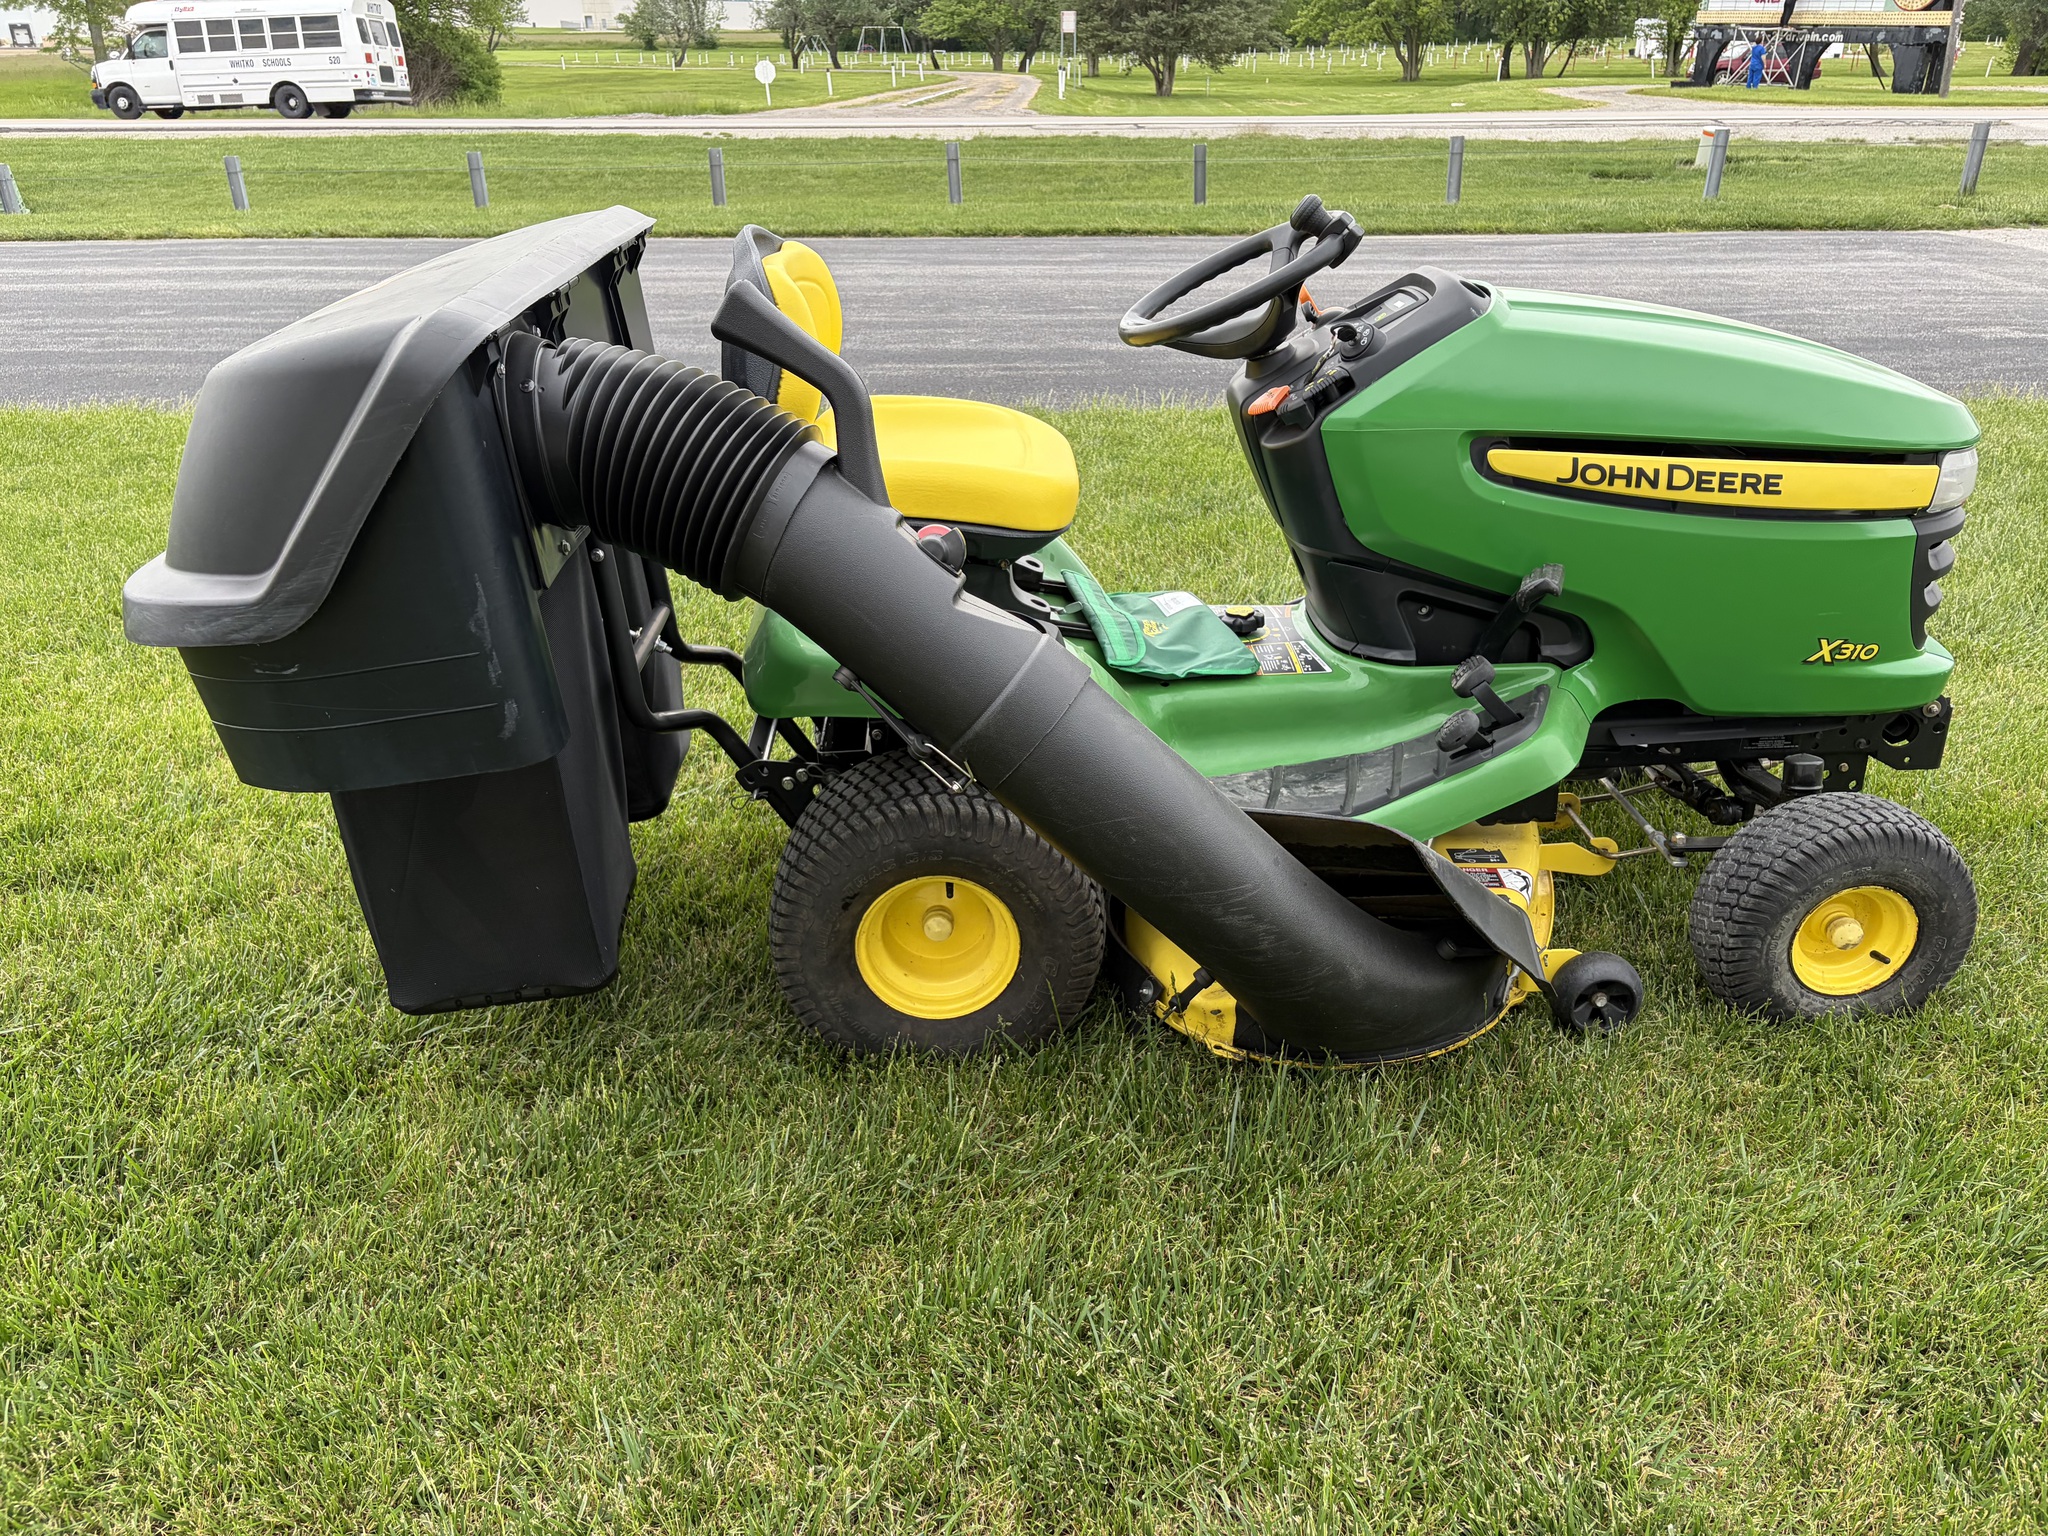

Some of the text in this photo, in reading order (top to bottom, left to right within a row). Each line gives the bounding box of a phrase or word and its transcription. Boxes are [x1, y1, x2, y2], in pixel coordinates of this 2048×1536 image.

[229, 56, 341, 68] WHITKO SCHOOLS 520
[1556, 457, 1784, 496] JOHN DEERE
[1802, 637, 1880, 666] X310
